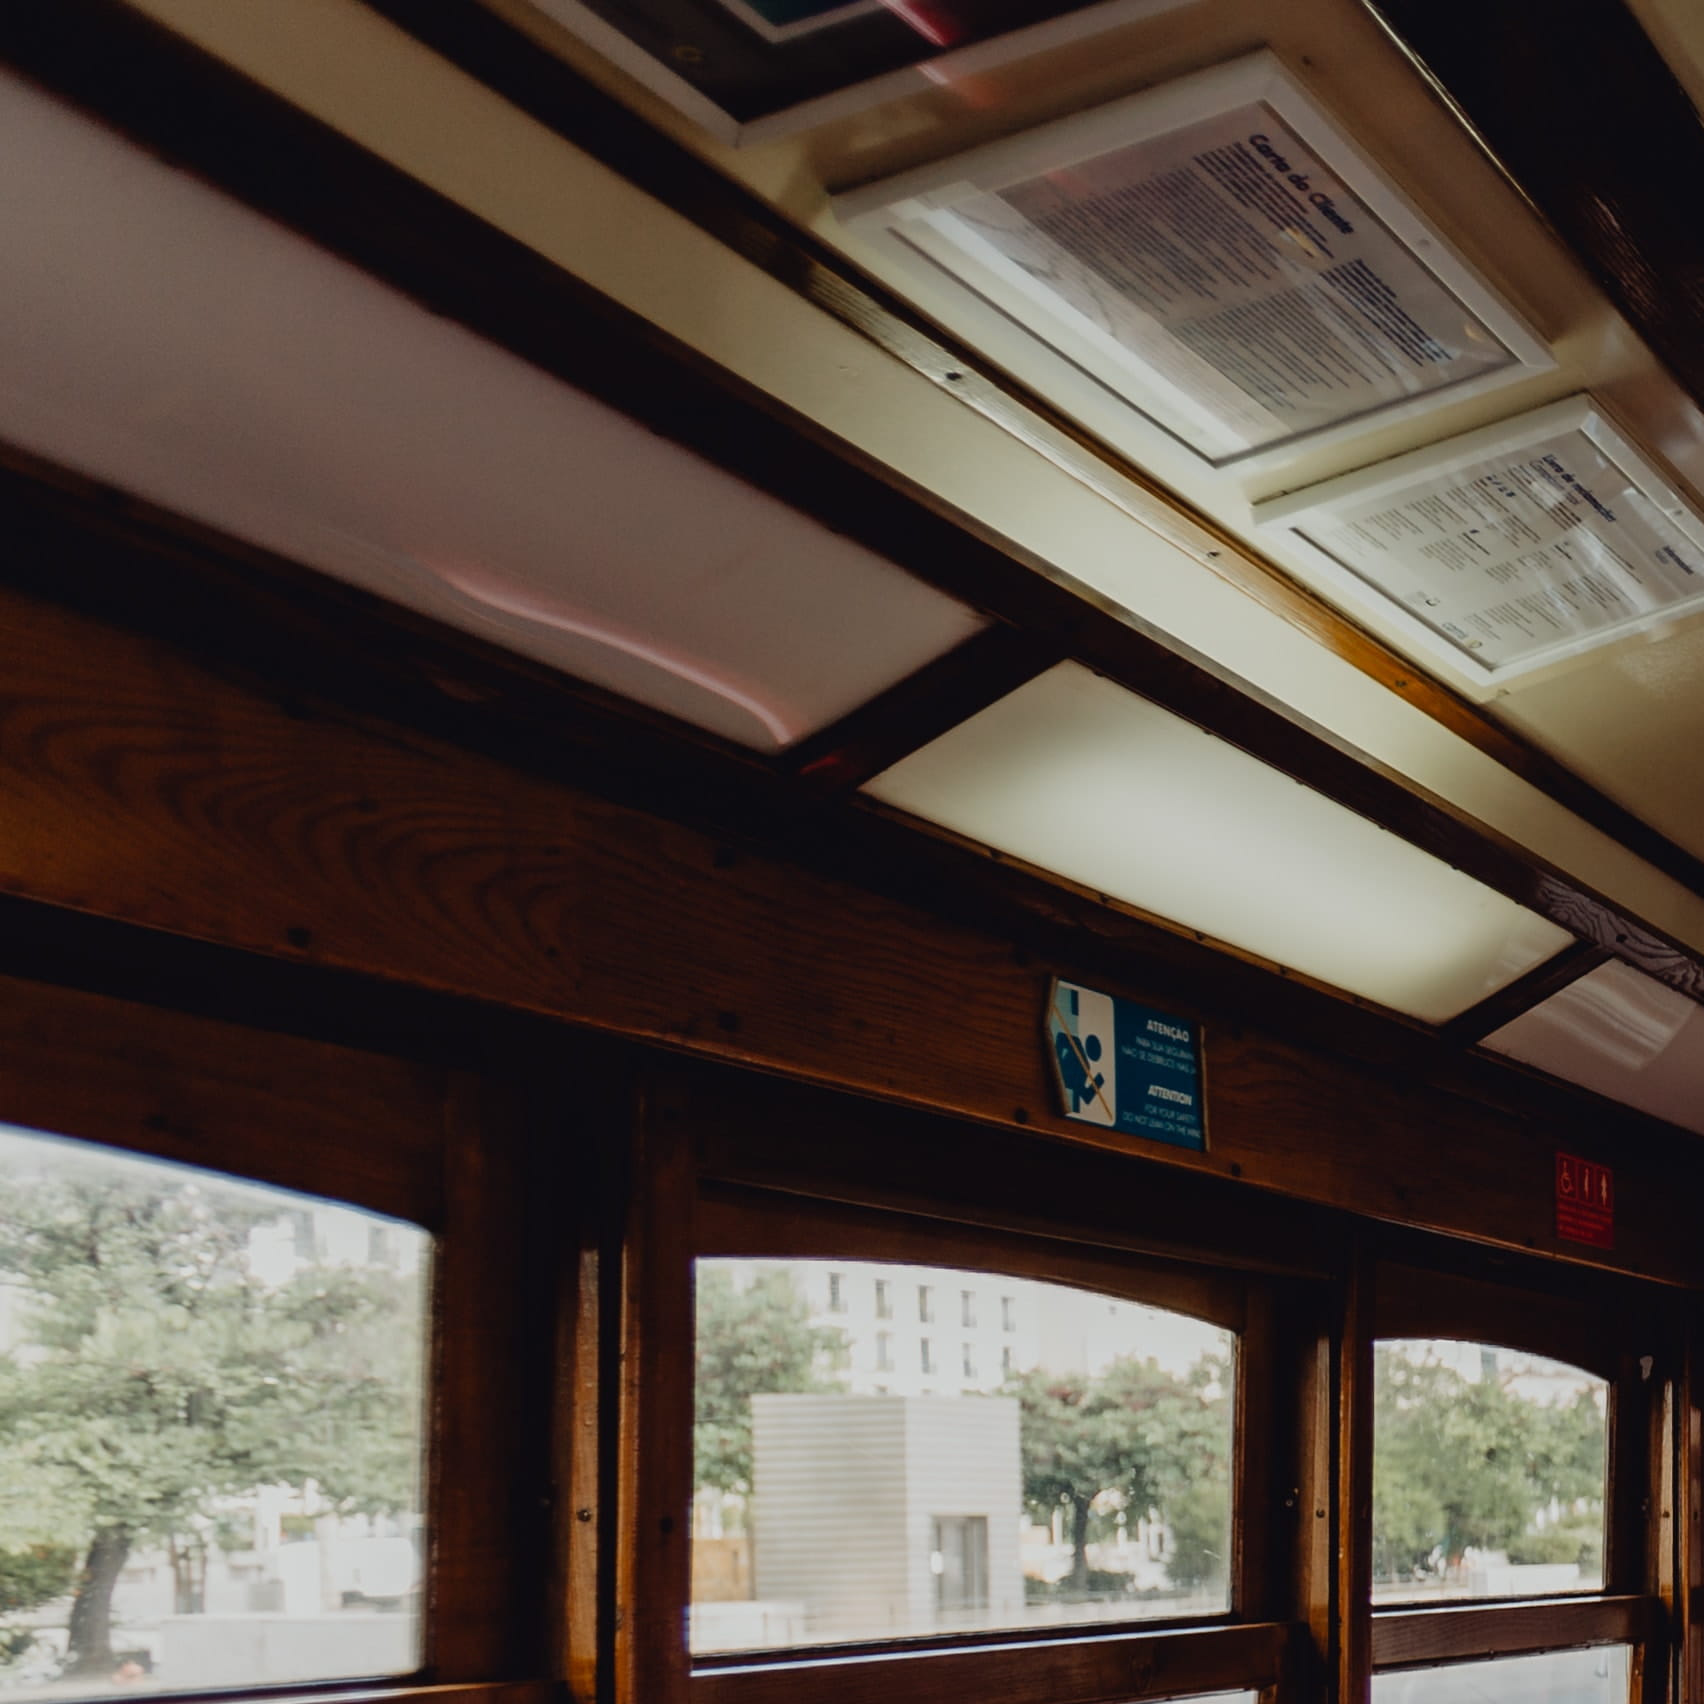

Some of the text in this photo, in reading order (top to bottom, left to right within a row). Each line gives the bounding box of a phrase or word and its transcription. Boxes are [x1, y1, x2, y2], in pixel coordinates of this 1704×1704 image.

[1248, 134, 1354, 234] Carta do Cliente
[1146, 1019, 1190, 1043] ATENÇÃO
[1147, 1084, 1192, 1106] ATTENTION
